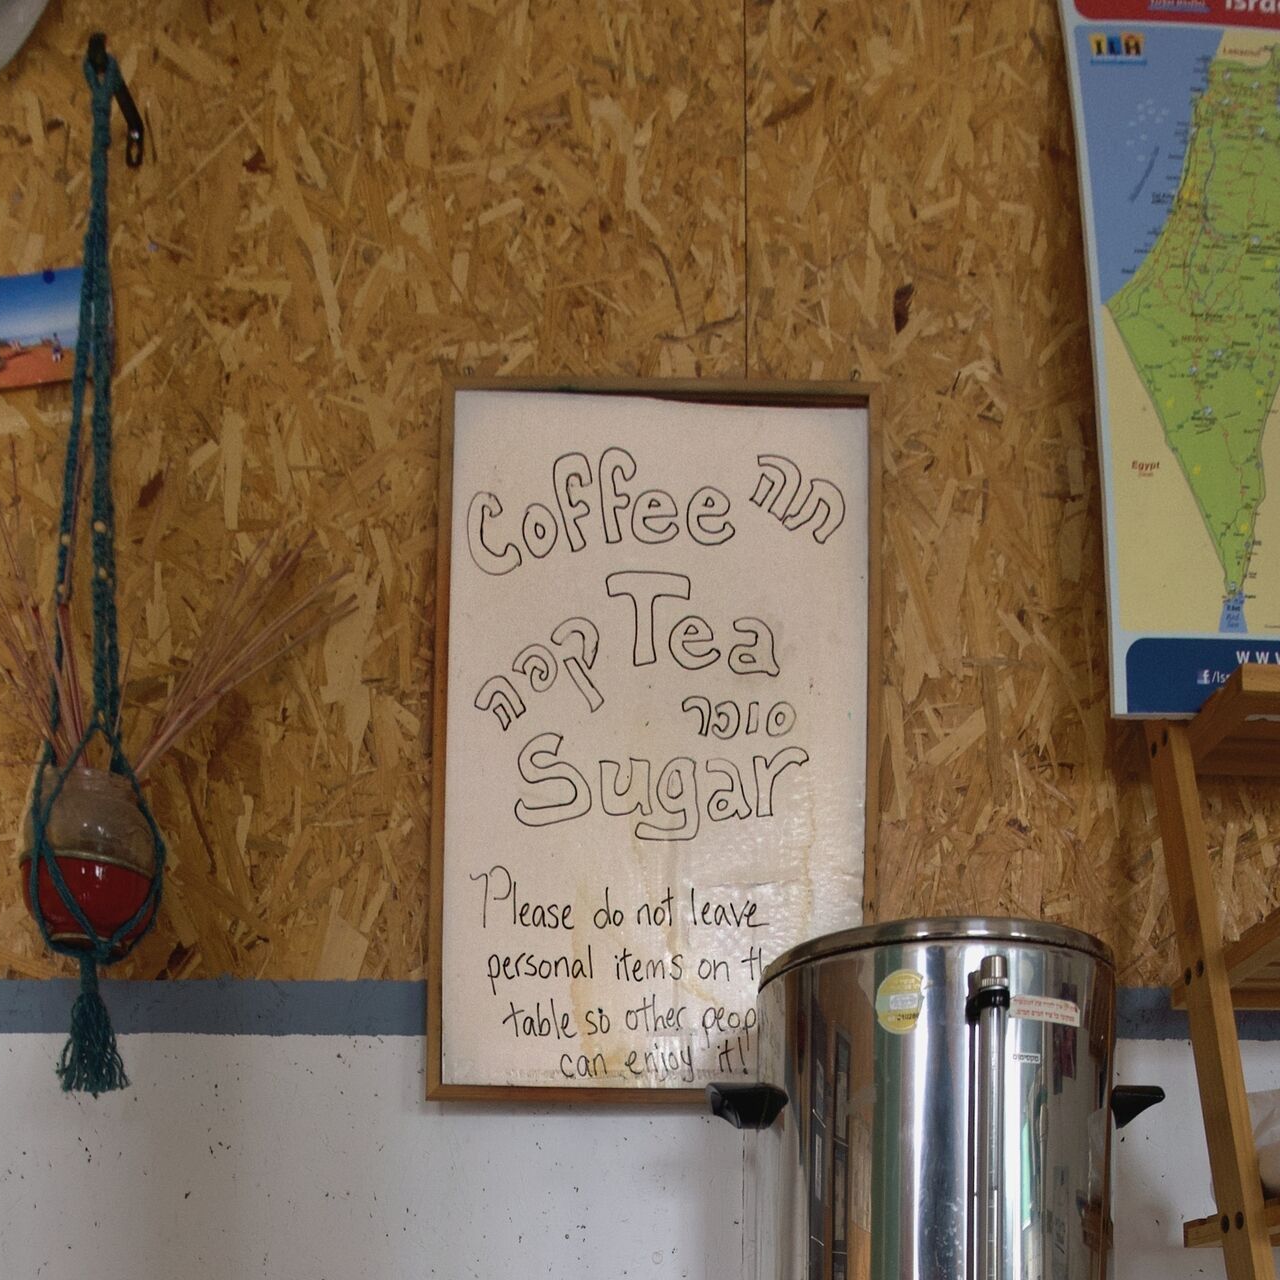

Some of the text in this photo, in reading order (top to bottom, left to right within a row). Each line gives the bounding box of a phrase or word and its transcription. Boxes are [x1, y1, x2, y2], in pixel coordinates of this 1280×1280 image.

[1131, 459, 1160, 472] Egypt
[467, 447, 736, 577] Coffee
[749, 454, 846, 545] תה
[605, 570, 781, 678] Tea
[474, 616, 605, 732] קפה
[681, 695, 797, 740] סוכר
[513, 732, 810, 842] Sugar
[469, 865, 771, 930] Please do not leave
[486, 945, 595, 996] personal
[613, 952, 684, 983] items
[697, 957, 731, 982] on
[503, 1001, 578, 1041] table
[586, 1006, 612, 1036] so
[625, 1004, 687, 1034] other
[559, 1037, 750, 1083] can enjoy it!
